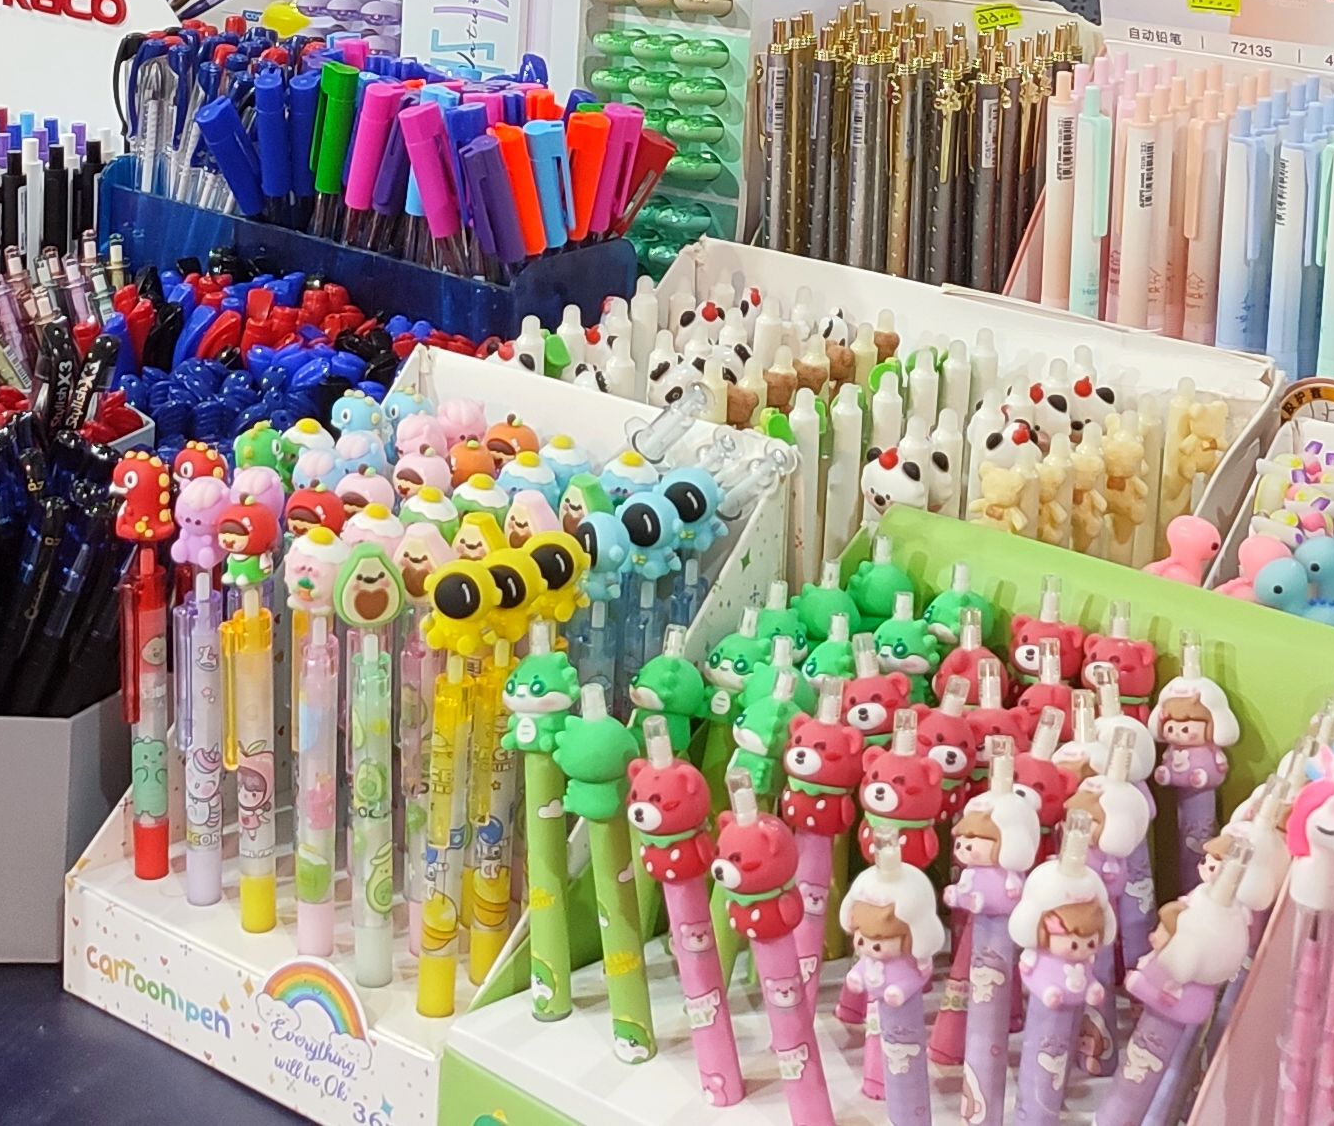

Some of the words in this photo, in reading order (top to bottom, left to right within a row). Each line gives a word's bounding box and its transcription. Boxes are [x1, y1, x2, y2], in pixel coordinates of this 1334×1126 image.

[1230, 40, 1273, 59] 72135
[271, 1018, 357, 1081] Everything
[274, 1055, 302, 1081] will
[304, 1063, 320, 1087] be
